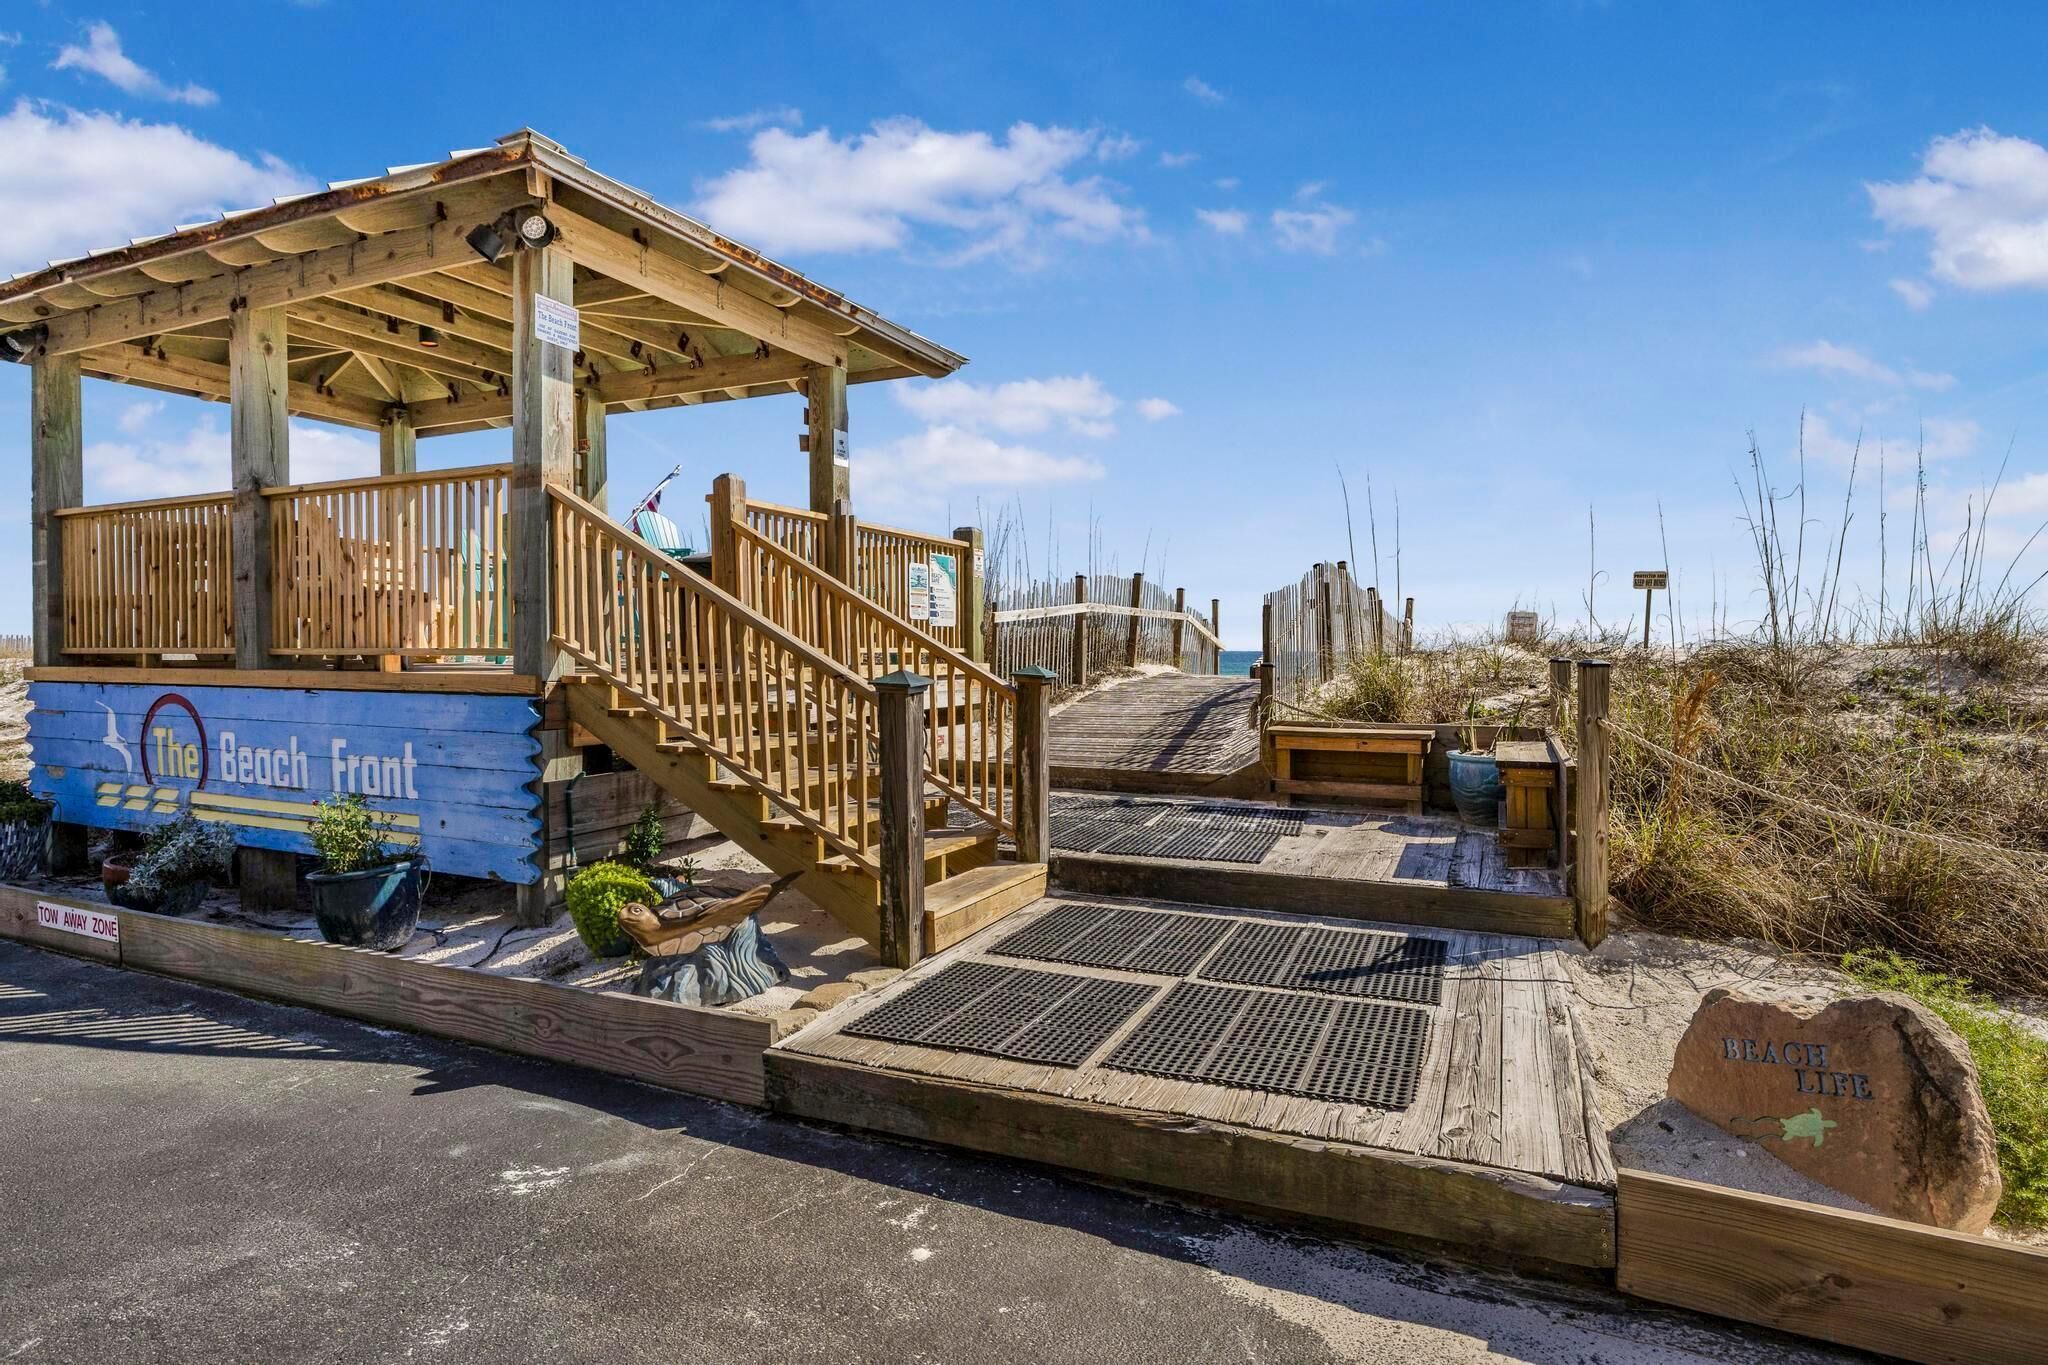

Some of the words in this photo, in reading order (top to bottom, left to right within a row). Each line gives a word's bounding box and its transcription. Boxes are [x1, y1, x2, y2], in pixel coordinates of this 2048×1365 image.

[538, 310, 547, 320] The
[548, 314, 563, 326] Beach
[152, 726, 199, 778] The
[220, 731, 308, 788] Beach
[331, 738, 418, 799] Front
[39, 906, 58, 924] TOW
[64, 912, 87, 930] AWAY
[92, 917, 118, 938] ZONE
[1722, 1037, 1827, 1067] BEACH
[1794, 1069, 1873, 1099] LIFE
